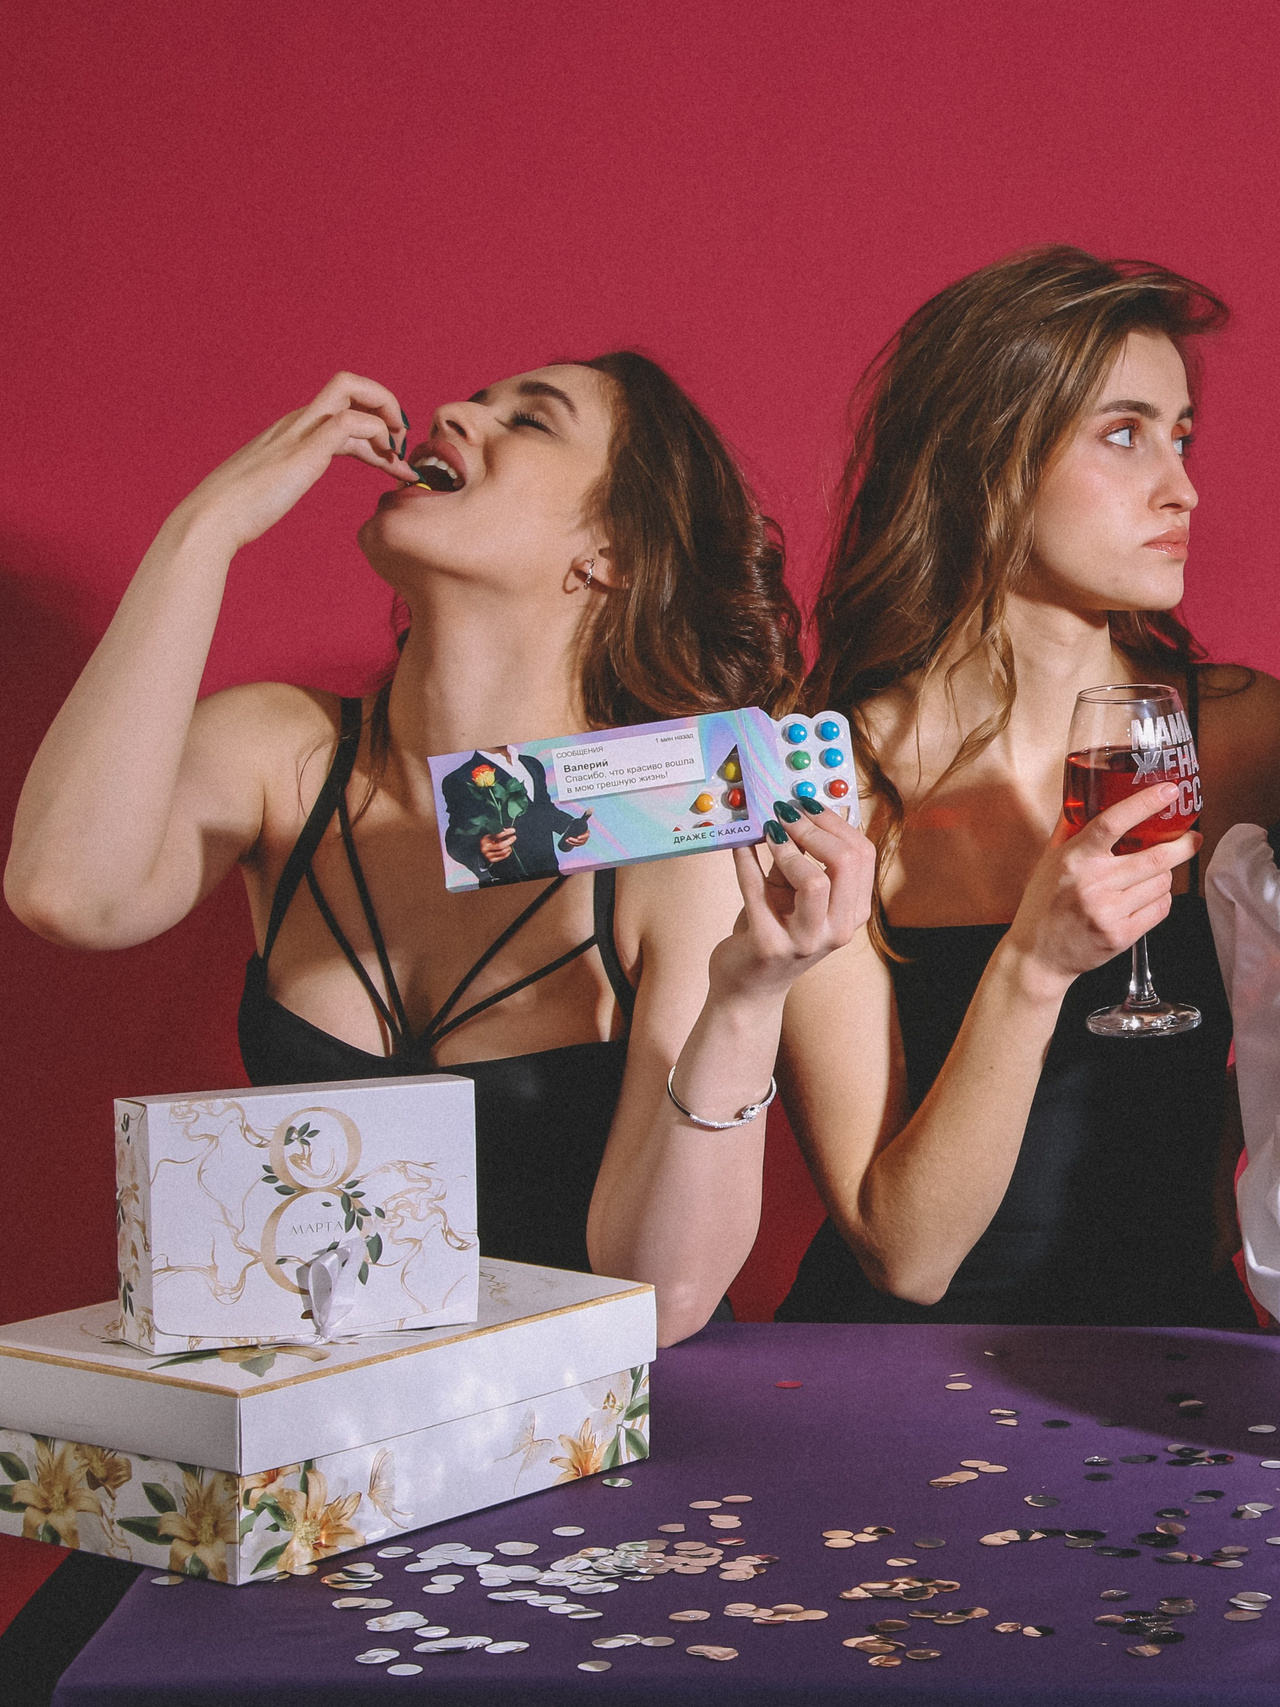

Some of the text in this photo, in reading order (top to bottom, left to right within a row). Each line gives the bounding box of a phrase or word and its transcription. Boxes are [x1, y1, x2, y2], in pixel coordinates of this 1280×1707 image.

[674, 733, 694, 742] назад
[1131, 710, 1193, 751] МАМА
[556, 745, 604, 759] СООБЩЕНИЯ
[563, 758, 609, 773] Валерий
[565, 757, 695, 784] Спасибо, что красиво вошла
[1131, 742, 1200, 785] ЖЕНА
[566, 771, 669, 794] в мою грешную жизнь!
[673, 825, 751, 845] ДРАЖЕ С КАКАО
[289, 1220, 344, 1236] МАРТА
